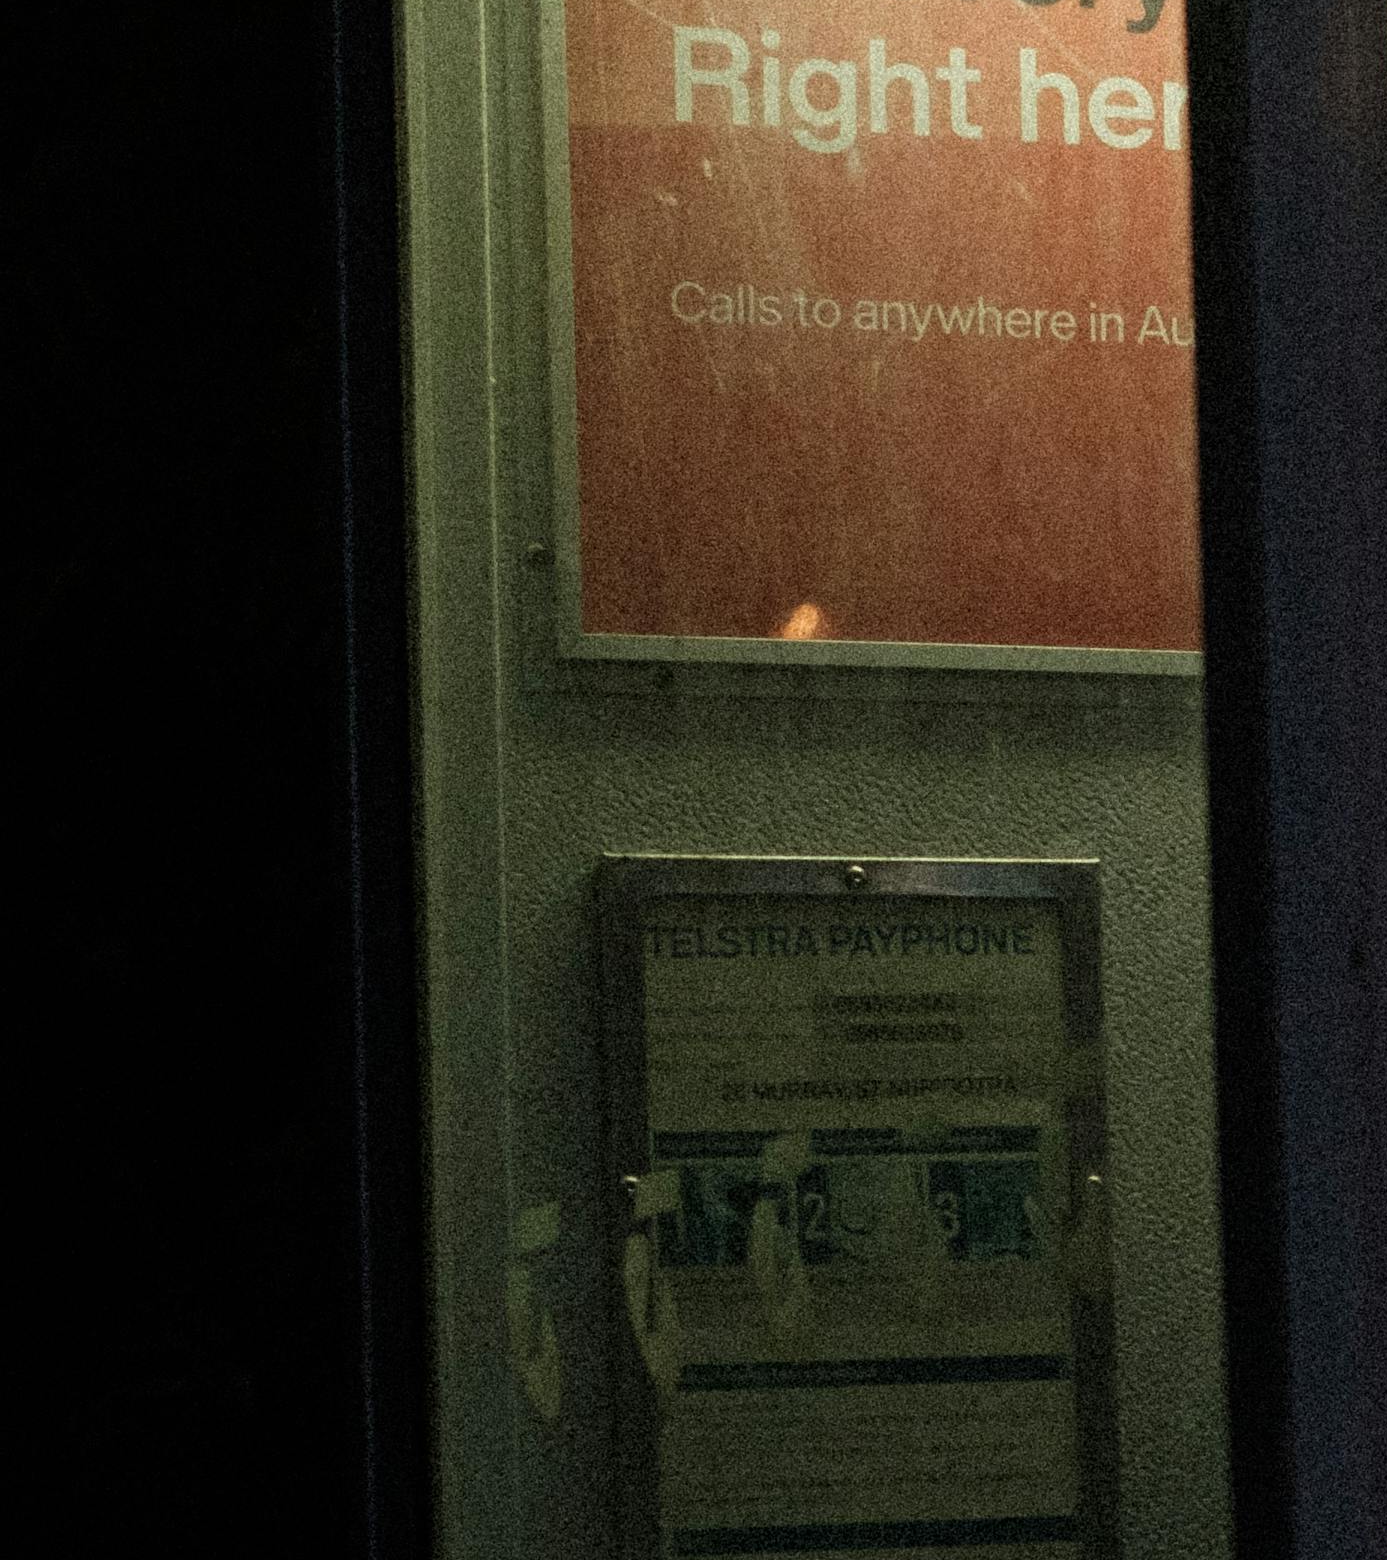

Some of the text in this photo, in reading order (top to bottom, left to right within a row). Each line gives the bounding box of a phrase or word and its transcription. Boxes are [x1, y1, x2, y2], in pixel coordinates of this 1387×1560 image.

[673, 27, 1188, 152] Right her
[670, 280, 783, 329] Calls
[793, 292, 841, 329] to
[855, 297, 1075, 359] anywhere
[1090, 303, 1125, 343] in
[649, 924, 1034, 958] TELSTRA PAYPHONE
[802, 1194, 827, 1240] 2
[935, 1194, 961, 1239] 3
